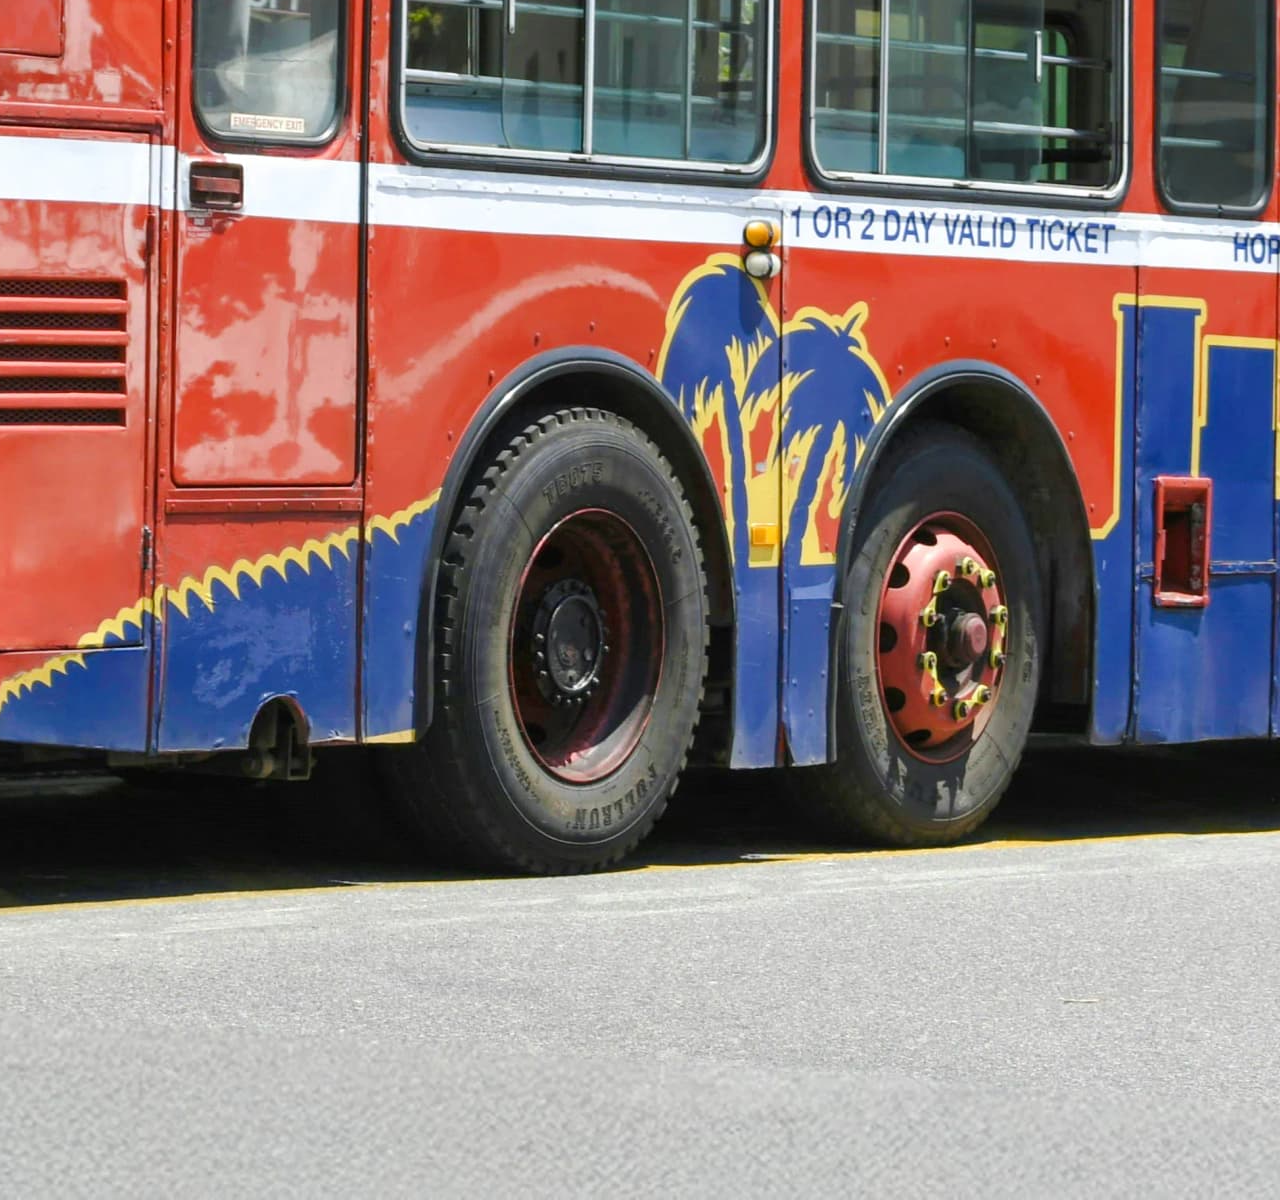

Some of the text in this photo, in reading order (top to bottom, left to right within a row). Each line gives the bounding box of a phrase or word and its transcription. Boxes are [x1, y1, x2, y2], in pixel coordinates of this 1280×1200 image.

[233, 116, 303, 131] EMERGENCY EXIT
[791, 205, 1116, 254] 1 OR 2 DAY VALID TICKET
